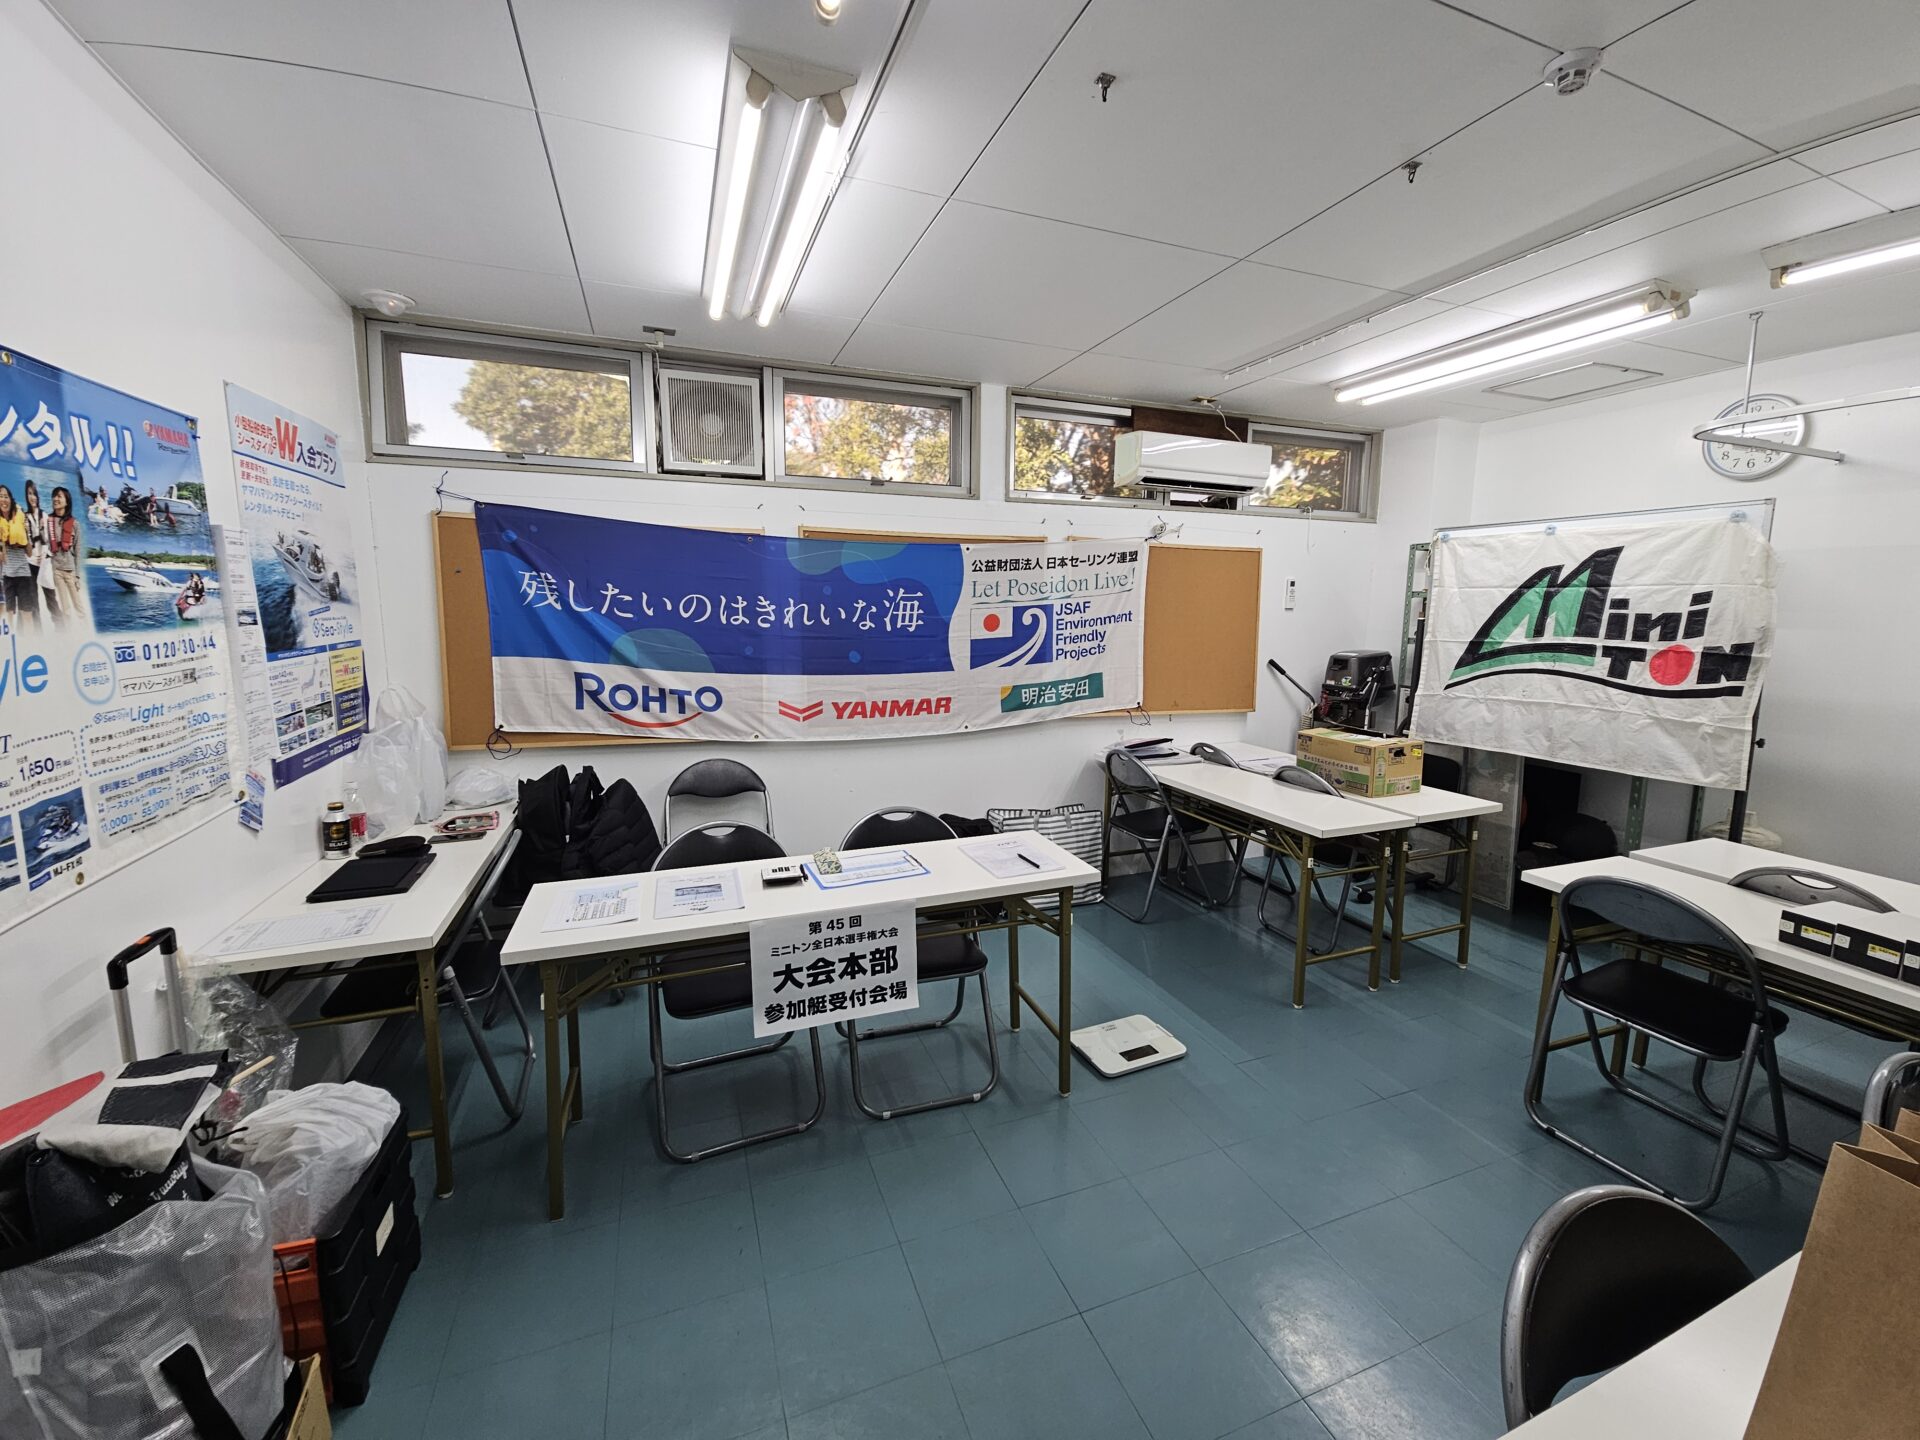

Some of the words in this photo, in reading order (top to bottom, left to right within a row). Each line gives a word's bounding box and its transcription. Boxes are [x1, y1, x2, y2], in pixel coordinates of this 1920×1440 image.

[1747, 459, 1755, 469] 6
[971, 558, 1043, 573] 公益財団法人
[1046, 550, 1139, 570] 日本セーリング連盟
[971, 580, 1001, 599] Let
[1007, 575, 1089, 597] Poseidon
[1094, 567, 1136, 591] Live!
[518, 569, 925, 633] 残したいのはきれいな海
[1056, 601, 1092, 616] JSAF
[1056, 610, 1133, 632] Environment
[1056, 630, 1107, 647] Friendly
[1056, 644, 1106, 662] Projects
[573, 671, 723, 715] ROHTO
[1021, 679, 1089, 706] 明治安田
[130, 703, 164, 723] Light
[831, 697, 952, 720] YANMAR
[809, 921, 822, 935] 第
[826, 917, 845, 932] 45
[849, 915, 862, 928] 回
[770, 926, 899, 957] ミニトン全日本選手権大会
[773, 945, 899, 994] 大会本部
[764, 980, 908, 1025] 参加艇受付会場
